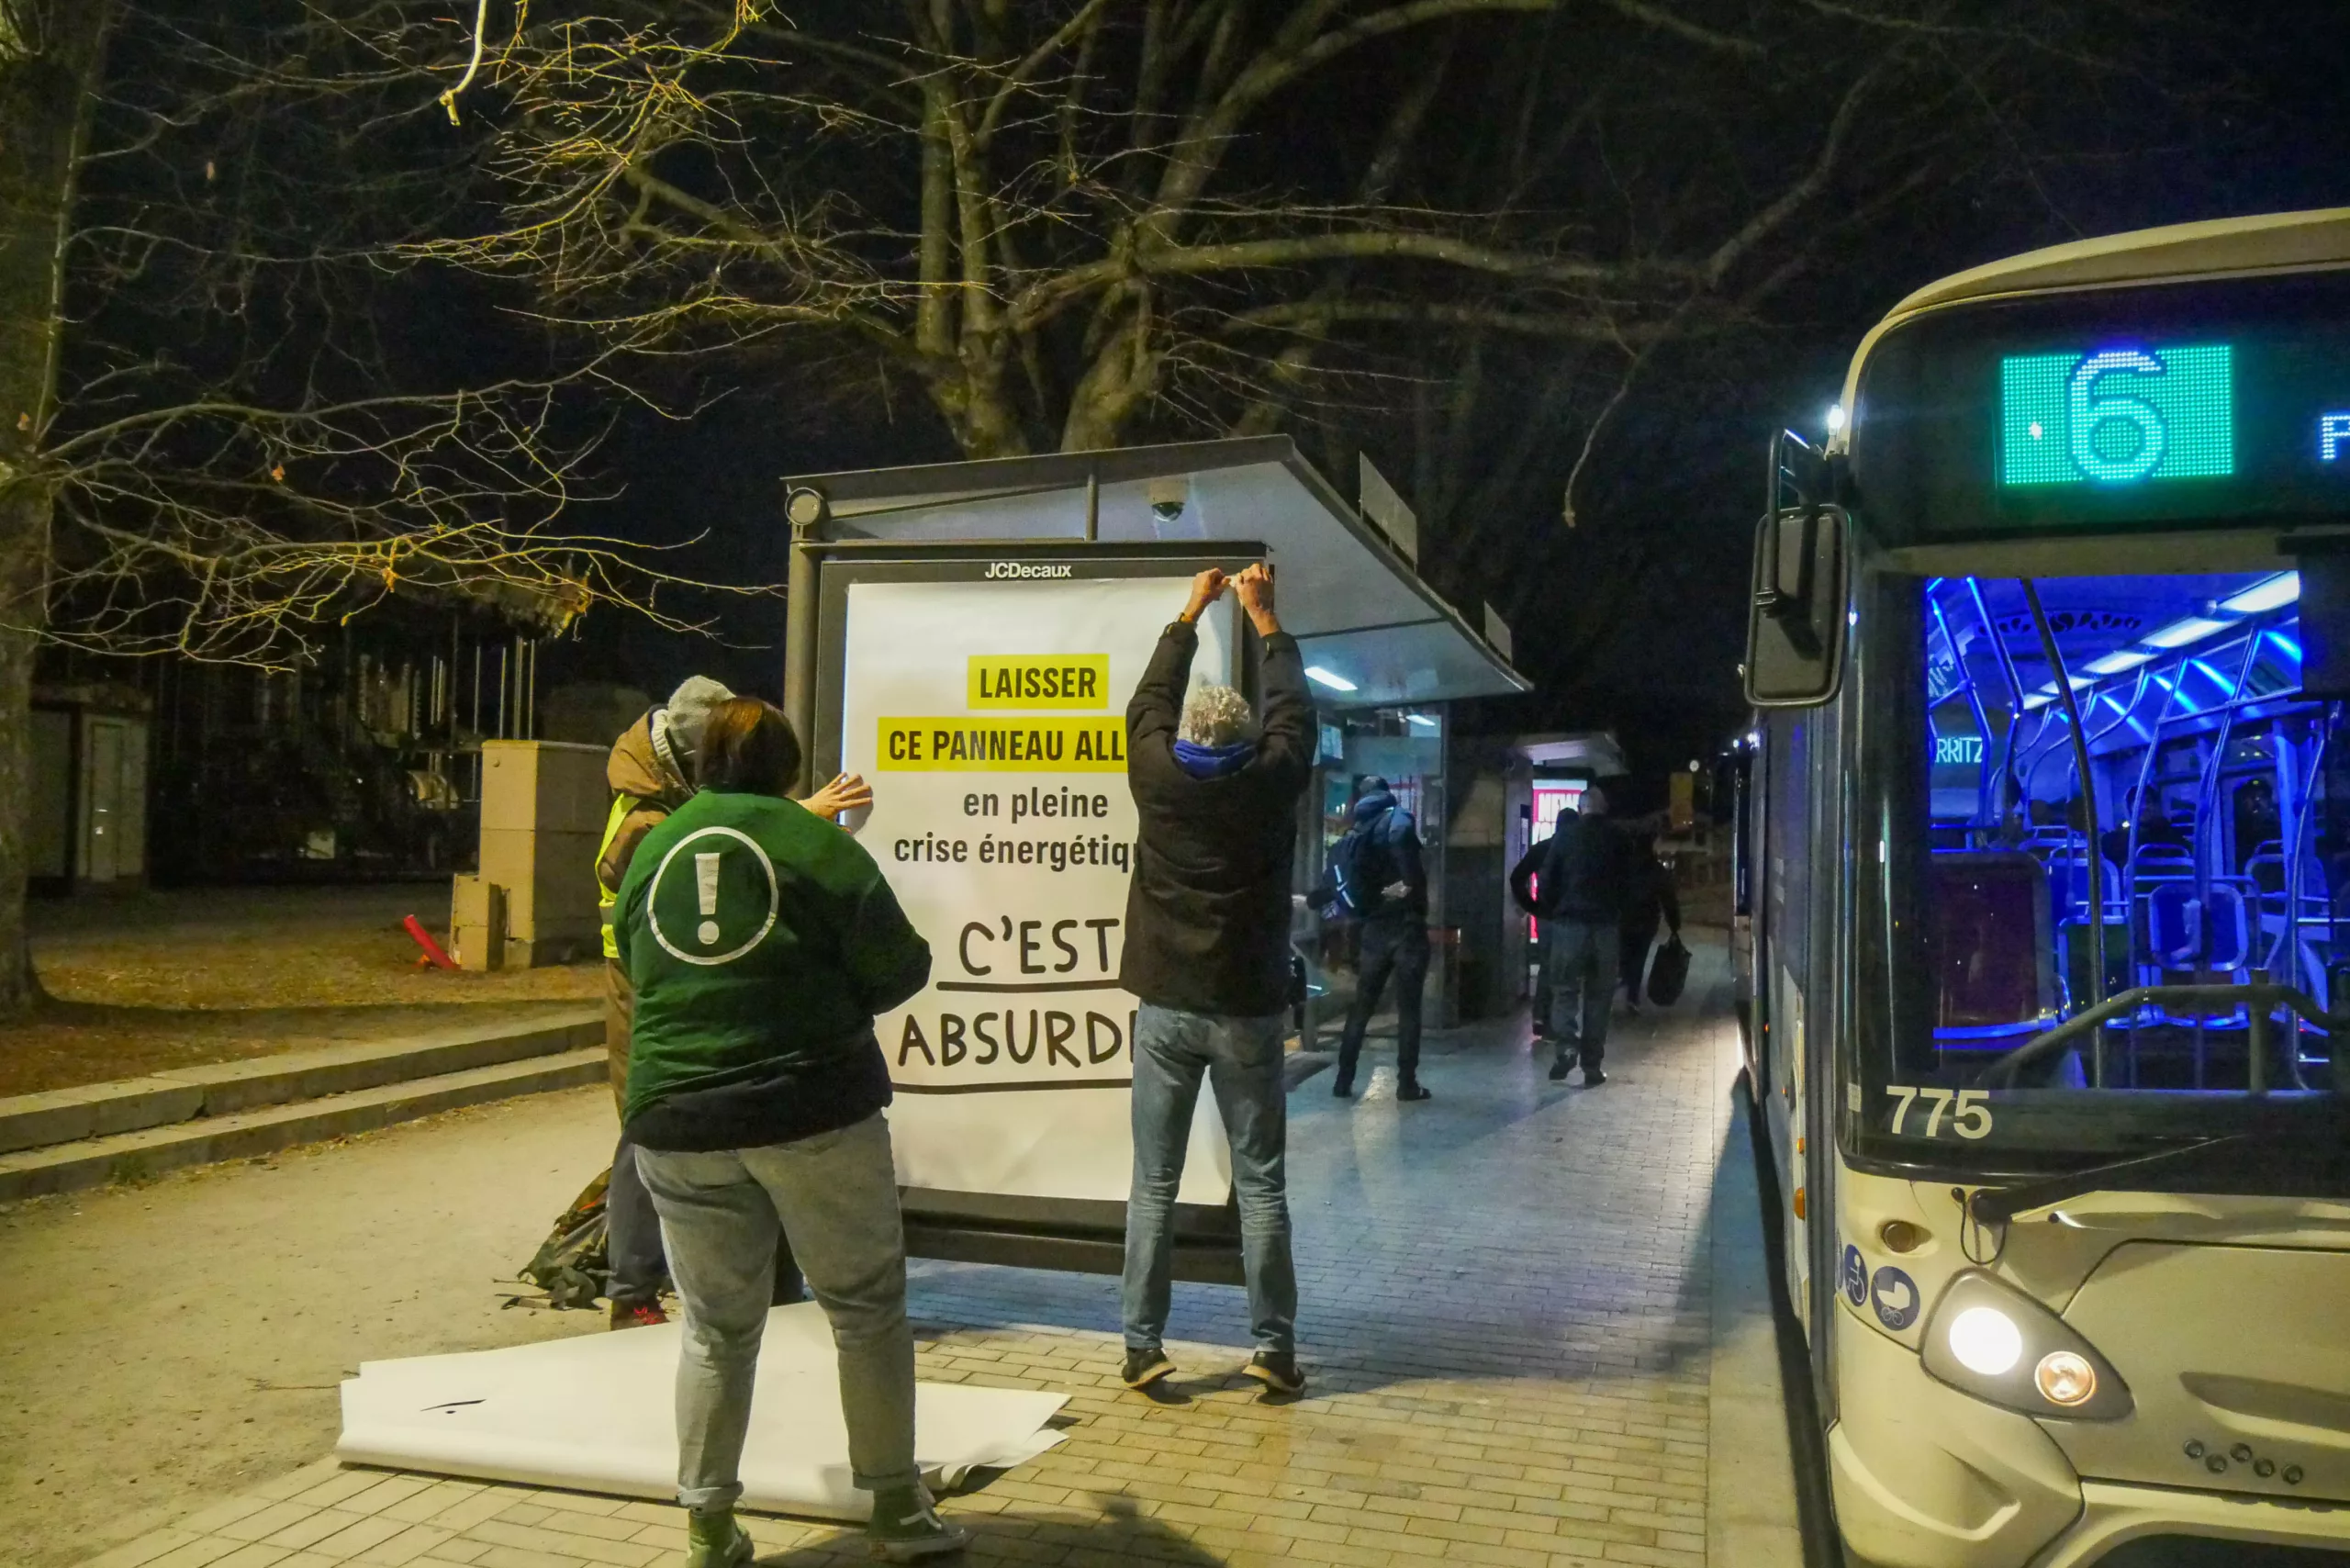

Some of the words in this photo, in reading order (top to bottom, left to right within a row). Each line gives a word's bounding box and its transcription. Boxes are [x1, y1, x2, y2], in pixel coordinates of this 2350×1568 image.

[2071, 351, 2163, 481] 6
[984, 562, 1072, 578] JCDecaux
[980, 667, 1096, 699] LAISSER
[889, 730, 922, 761] CE
[933, 730, 1063, 761] PANNEAU
[1074, 730, 1125, 761] ALL
[964, 793, 999, 817] en
[1012, 786, 1108, 824] pleine
[894, 831, 968, 863] crise
[958, 914, 1120, 977] C'EST
[1886, 1085, 1993, 1139] 775
